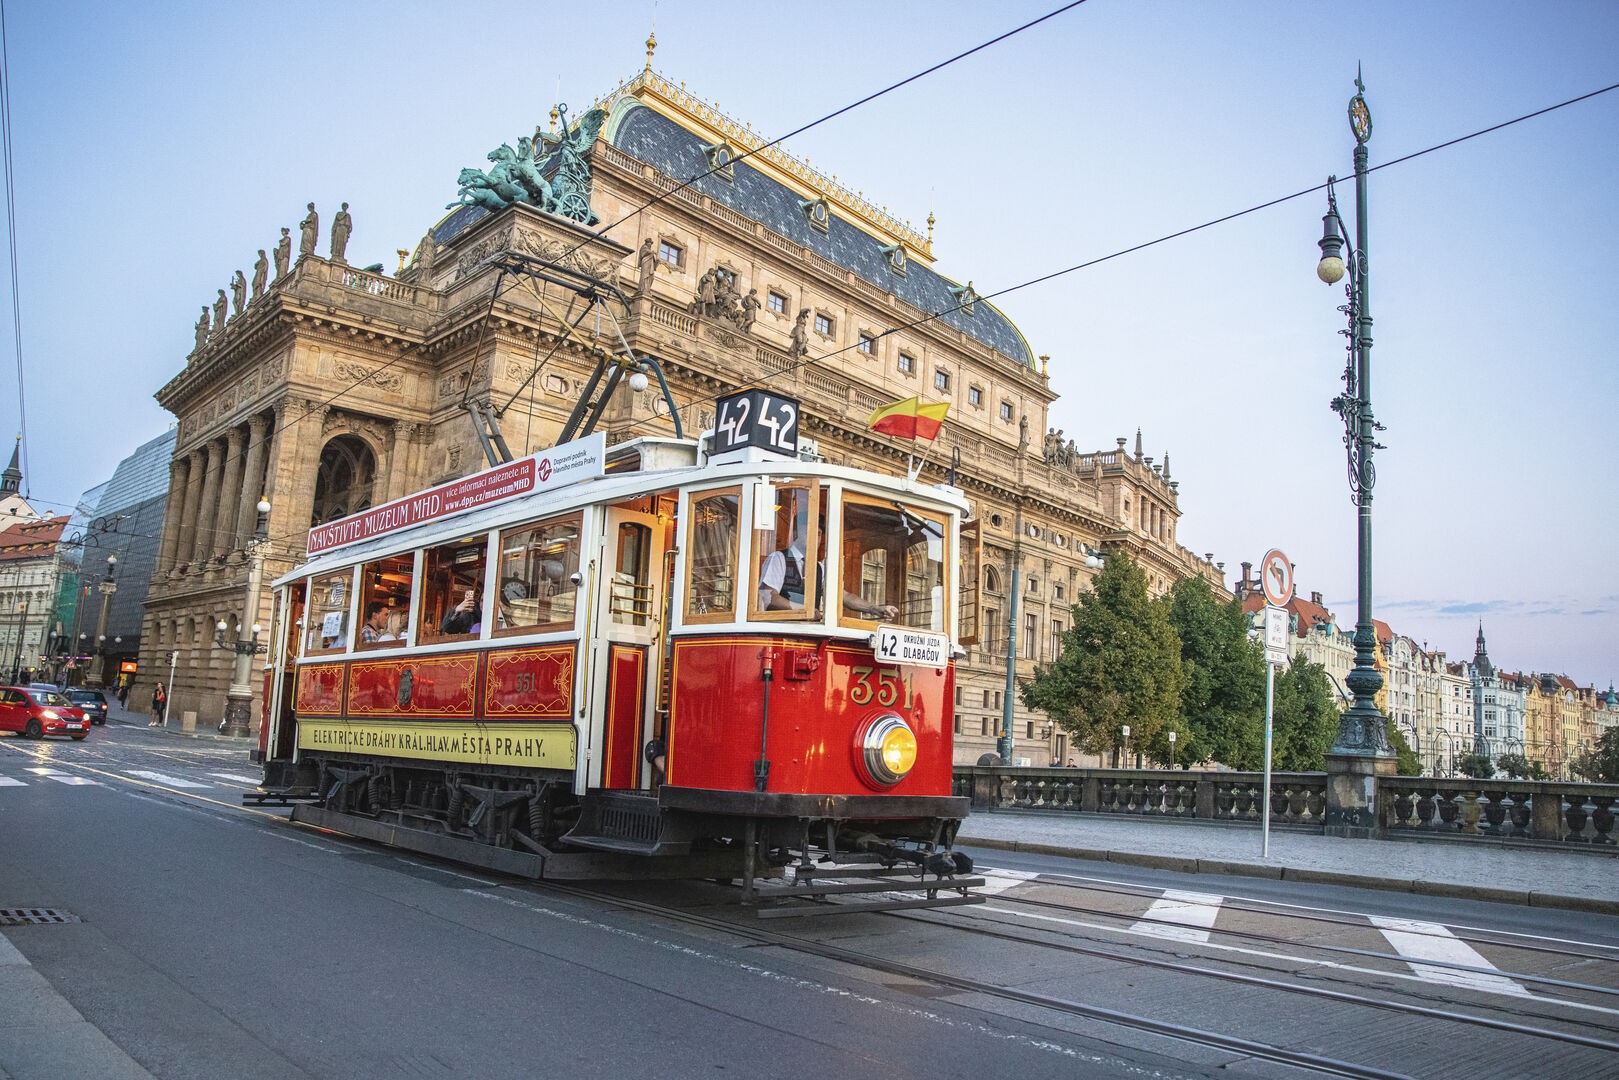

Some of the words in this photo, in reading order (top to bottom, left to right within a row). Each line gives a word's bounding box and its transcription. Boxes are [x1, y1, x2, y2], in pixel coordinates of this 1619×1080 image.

[717, 397, 751, 446] 42
[757, 397, 796, 451] 42
[572, 449, 587, 461] podnik
[584, 456, 597, 465] Prahy
[487, 467, 519, 485] naleznete
[520, 464, 530, 475] na
[444, 477, 530, 512] www.dpp.cz/muzeumMHD
[310, 519, 362, 551] NAVŠTIVTE
[363, 503, 409, 536] MUZEUM
[412, 494, 440, 521] MHD
[880, 633, 897, 657] 42
[903, 634, 926, 646] OKRUŽNÍ
[903, 646, 940, 662] DLABAČOV
[515, 672, 536, 693] 351
[850, 665, 914, 711] 351
[313, 729, 364, 747] ELEKTRICKÉ
[366, 730, 397, 749] DRÁHY
[495, 737, 546, 758] PRAHY.
